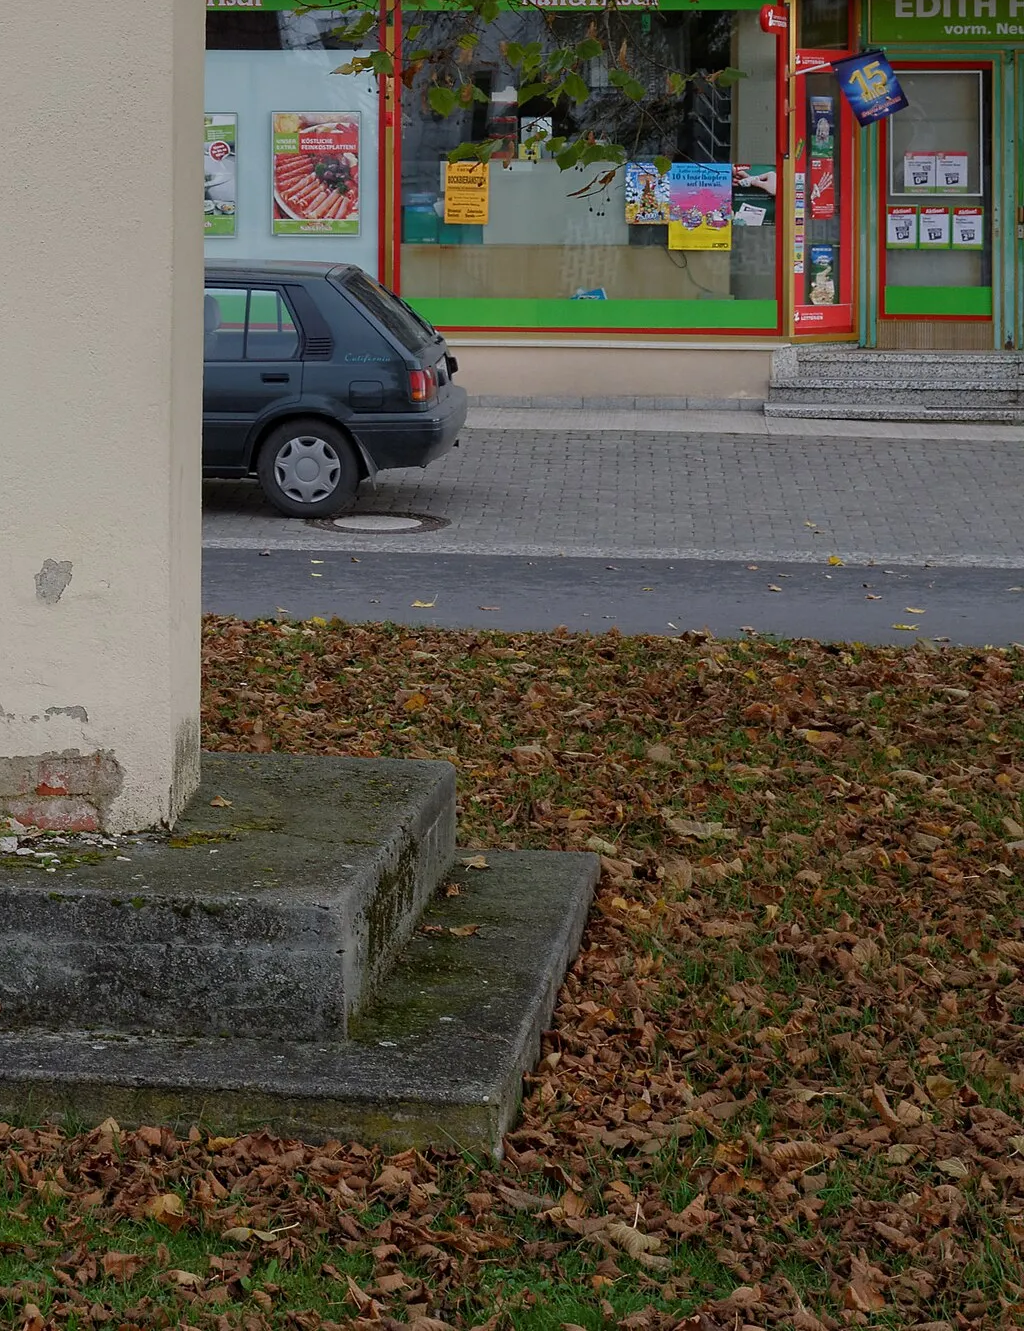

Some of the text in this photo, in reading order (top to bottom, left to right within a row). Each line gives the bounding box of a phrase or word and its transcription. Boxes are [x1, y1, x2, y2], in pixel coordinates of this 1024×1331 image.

[944, 25, 992, 35] vorm.
[849, 61, 888, 94] 15
[344, 352, 391, 362] California
